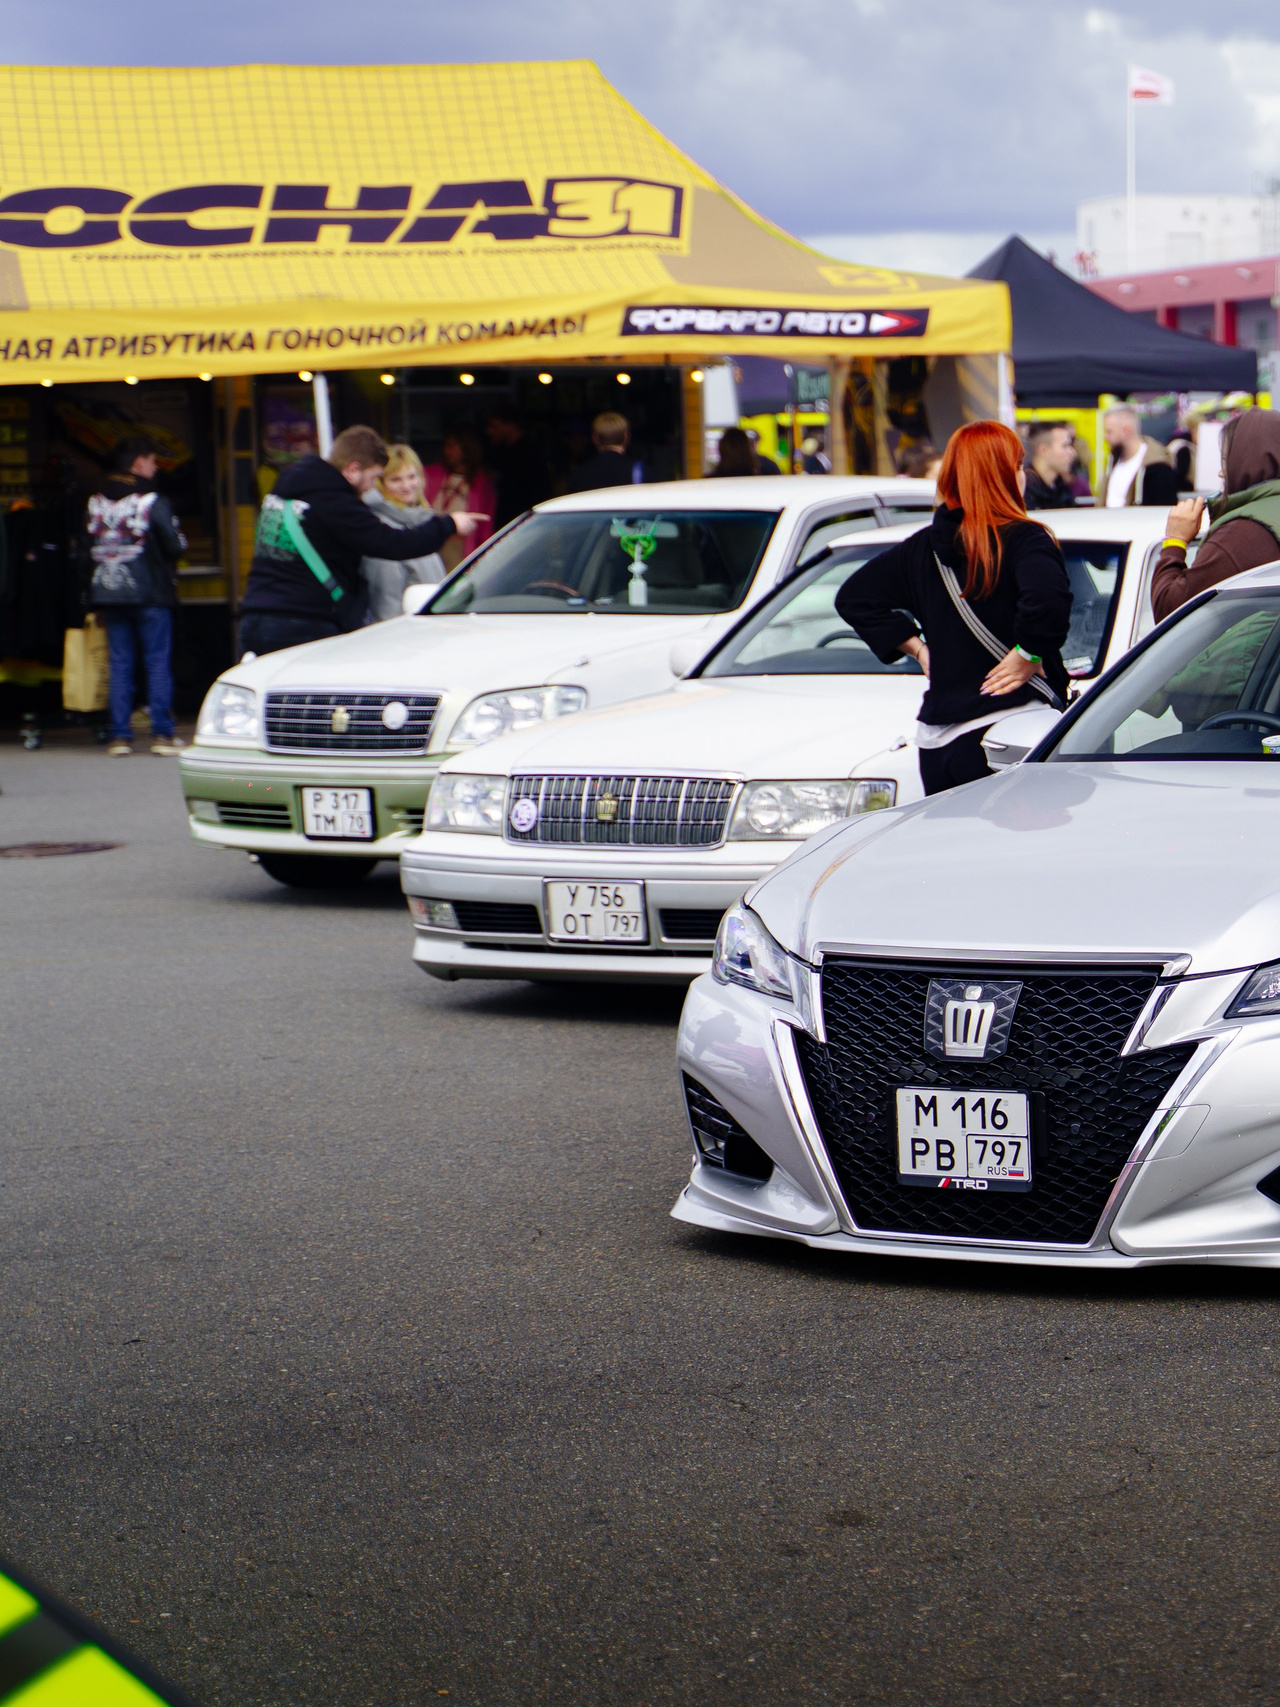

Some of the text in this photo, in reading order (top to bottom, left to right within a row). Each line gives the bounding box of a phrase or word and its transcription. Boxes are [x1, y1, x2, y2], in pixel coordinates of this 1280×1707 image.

[782, 311, 866, 334] АВТО
[62, 331, 255, 358] АТРИБУТИКА
[266, 318, 427, 350] ГОНОЧНОЙ
[437, 313, 587, 343] КОМАНДЫ
[331, 792, 358, 809] 317
[312, 814, 336, 832] ТМ
[588, 885, 625, 908] 756
[563, 913, 640, 935] ОТ 797
[915, 1094, 1009, 1130] М 116
[911, 1137, 1021, 1171] РВ 797
[987, 1166, 1007, 1176] RUS
[951, 1178, 989, 1190] TRD
